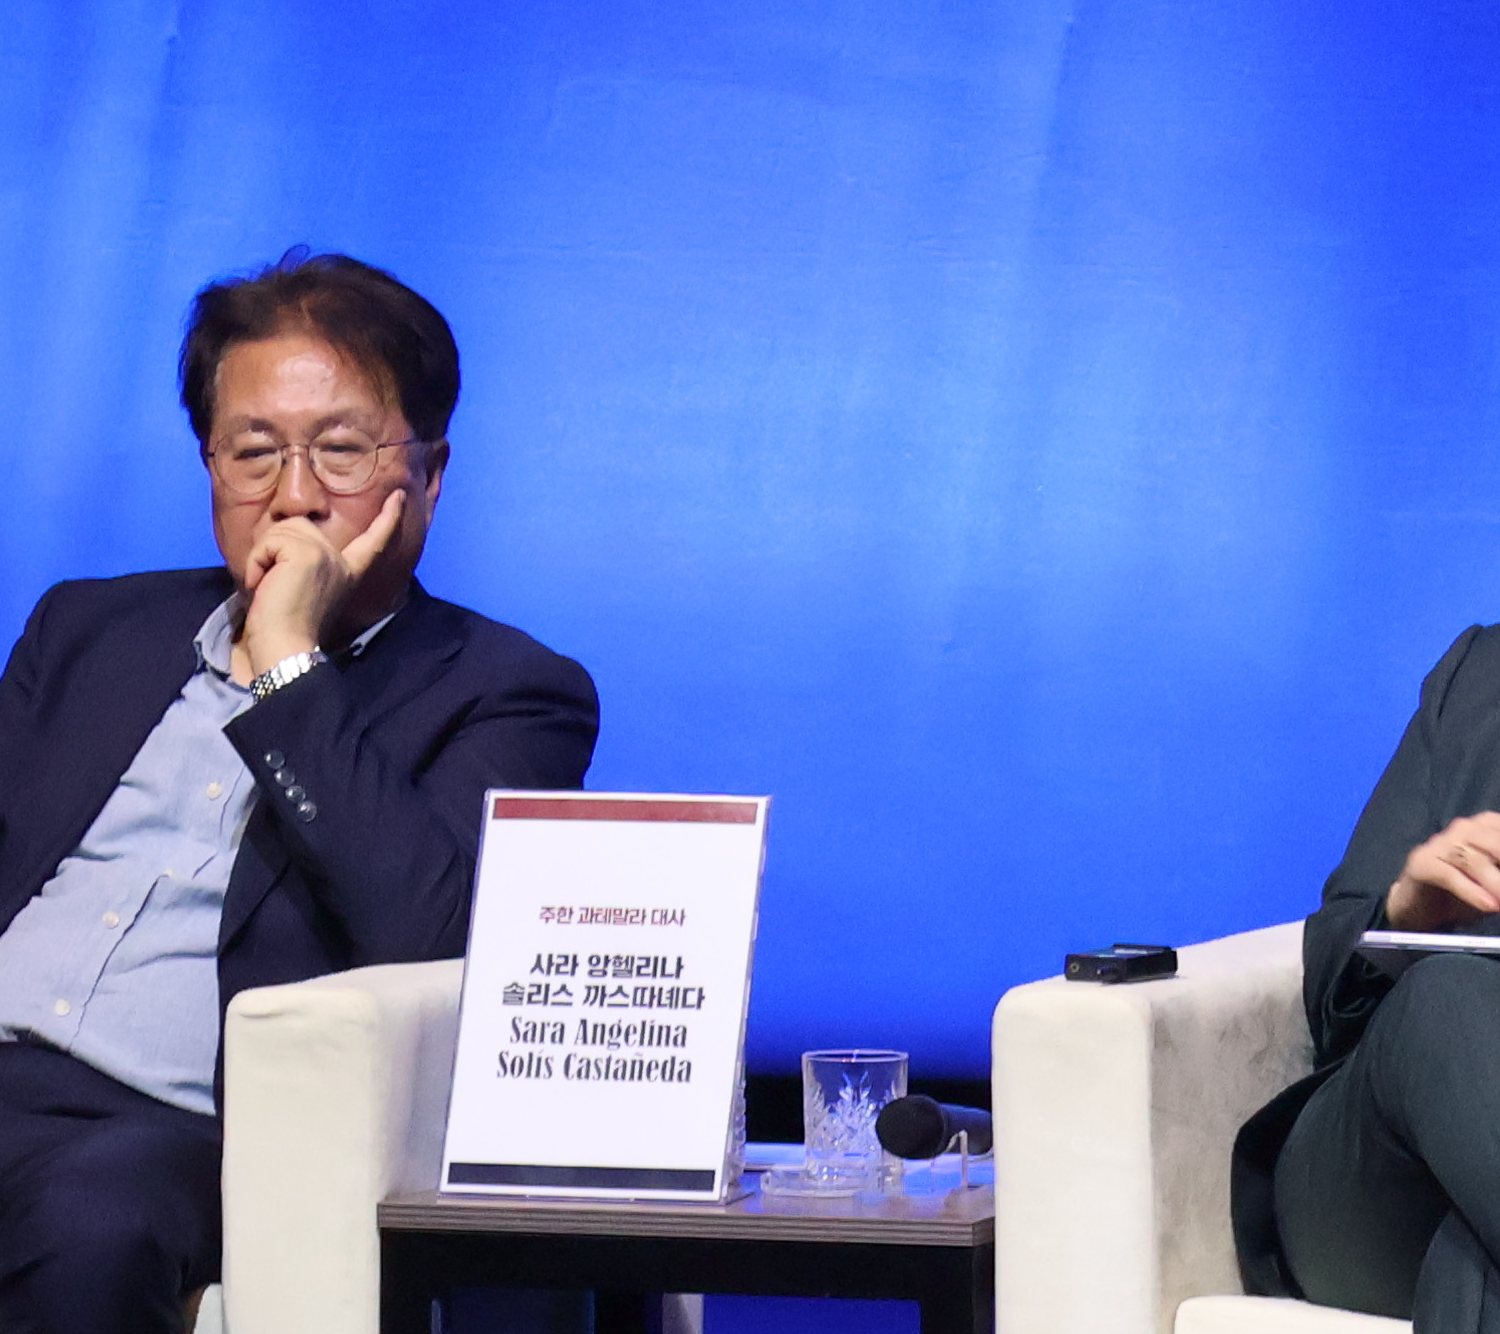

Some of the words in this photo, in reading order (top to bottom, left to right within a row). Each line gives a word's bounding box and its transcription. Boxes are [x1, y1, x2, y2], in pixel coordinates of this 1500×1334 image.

[539, 906, 575, 925] 주한
[578, 907, 647, 926] 과테말라
[650, 908, 687, 927] 대사
[530, 953, 580, 978] 사라
[587, 954, 685, 980] 앙헬리나
[502, 982, 575, 1007] 솔리스
[582, 985, 706, 1010] 까스따녜다
[510, 1016, 567, 1046] Sara
[574, 1018, 689, 1051] Angelina
[497, 1049, 555, 1080] Solís
[563, 1051, 693, 1084] Castañeda
